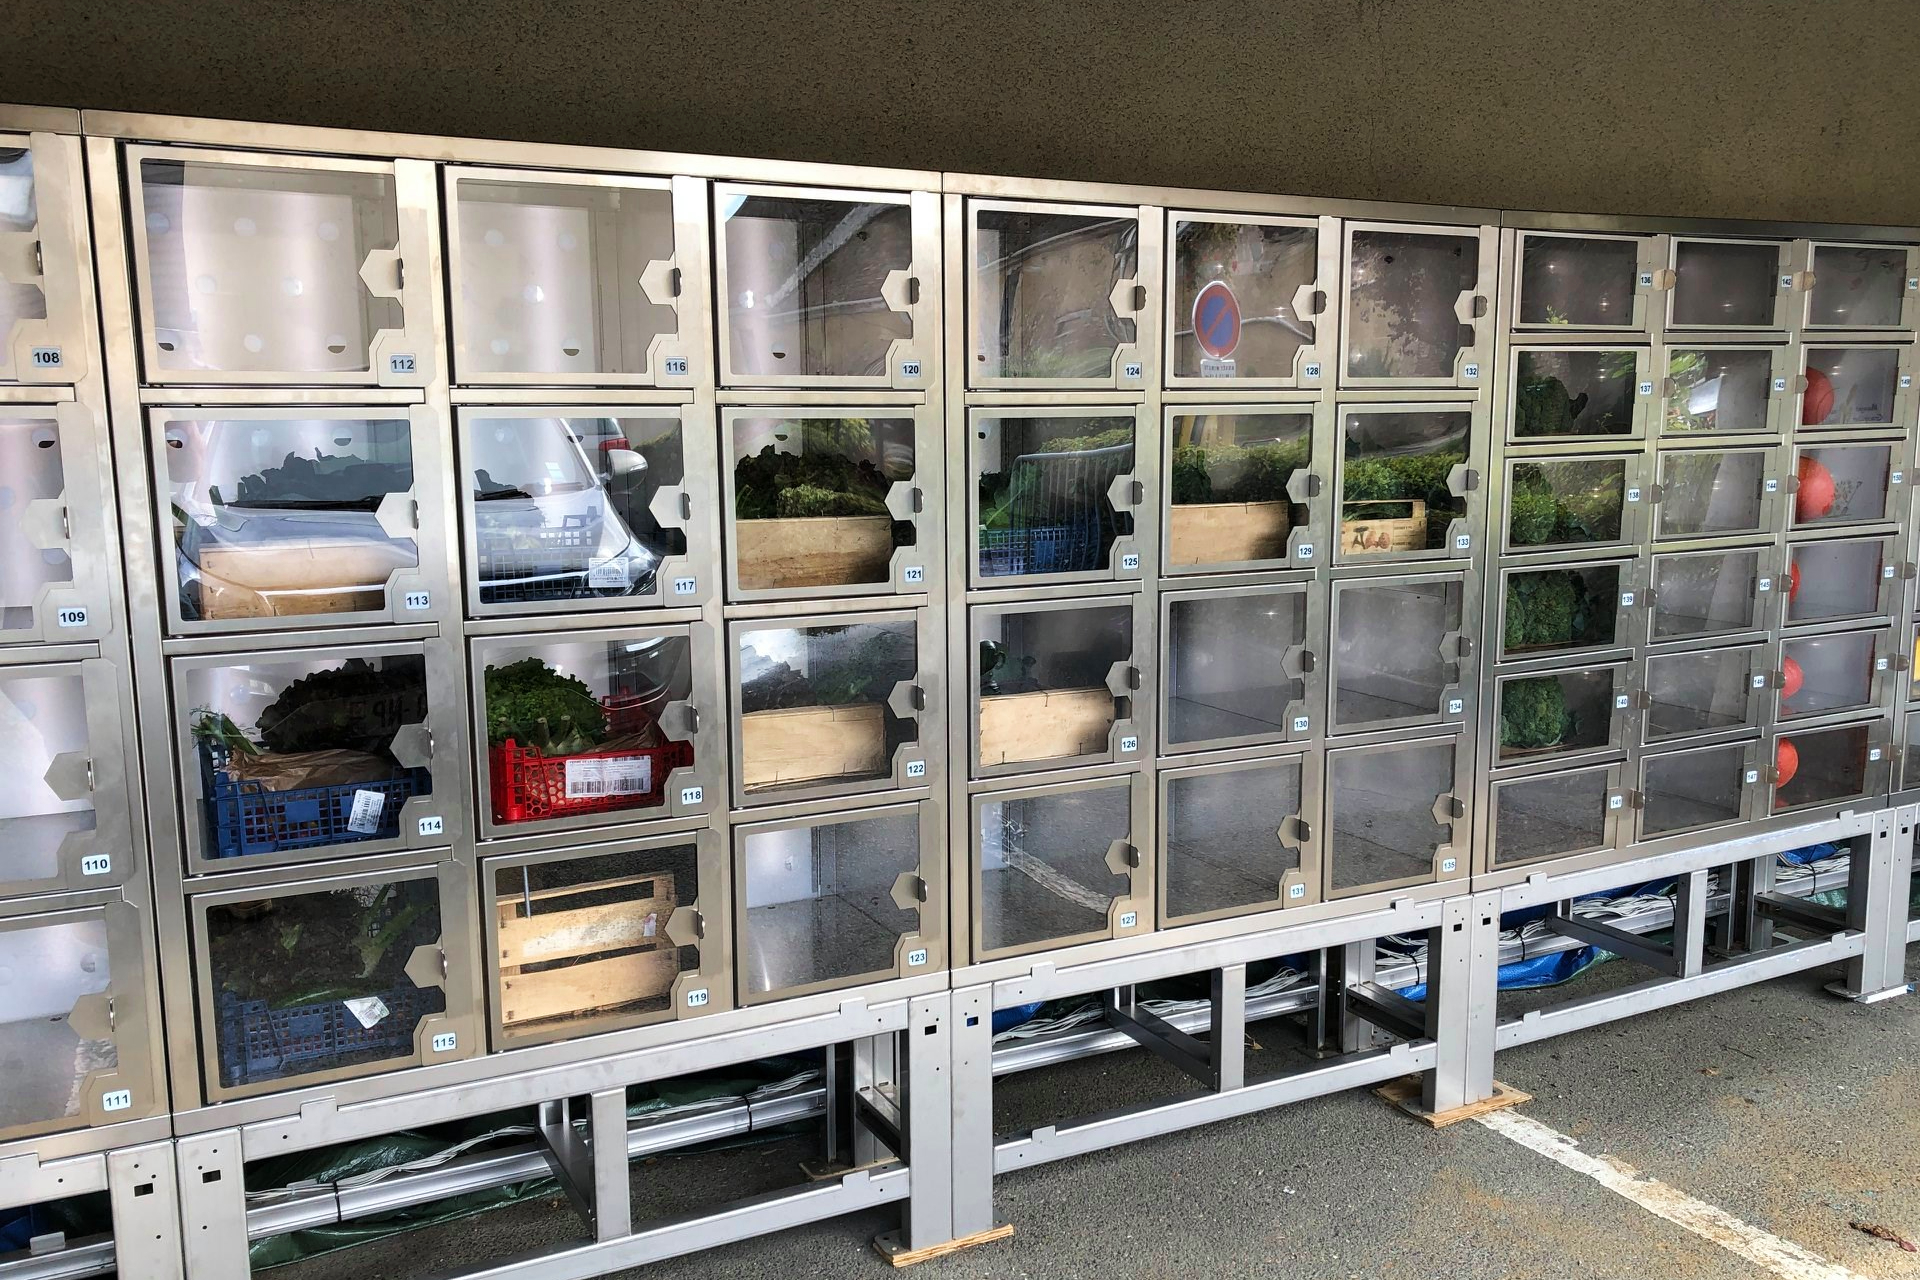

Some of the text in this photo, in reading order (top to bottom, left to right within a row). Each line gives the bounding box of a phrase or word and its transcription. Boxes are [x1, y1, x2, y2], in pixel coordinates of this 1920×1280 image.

[34, 352, 59, 363] 108
[391, 359, 414, 369] 112
[666, 362, 686, 372] 116
[903, 365, 919, 374] 120
[1126, 367, 1140, 375] 124
[1124, 558, 1138, 566] 125
[907, 570, 922, 579] 121
[676, 581, 694, 591] 117
[407, 596, 428, 606] 113
[60, 612, 85, 622] 109
[1123, 740, 1136, 748] 126
[909, 764, 924, 773] 122
[683, 791, 701, 800] 118
[420, 821, 441, 831] 114
[85, 859, 108, 870] 110
[1122, 916, 1135, 924] 127
[910, 953, 925, 962] 123
[689, 993, 707, 1003] 119
[434, 1037, 455, 1048] 115
[106, 1094, 128, 1106] 111
